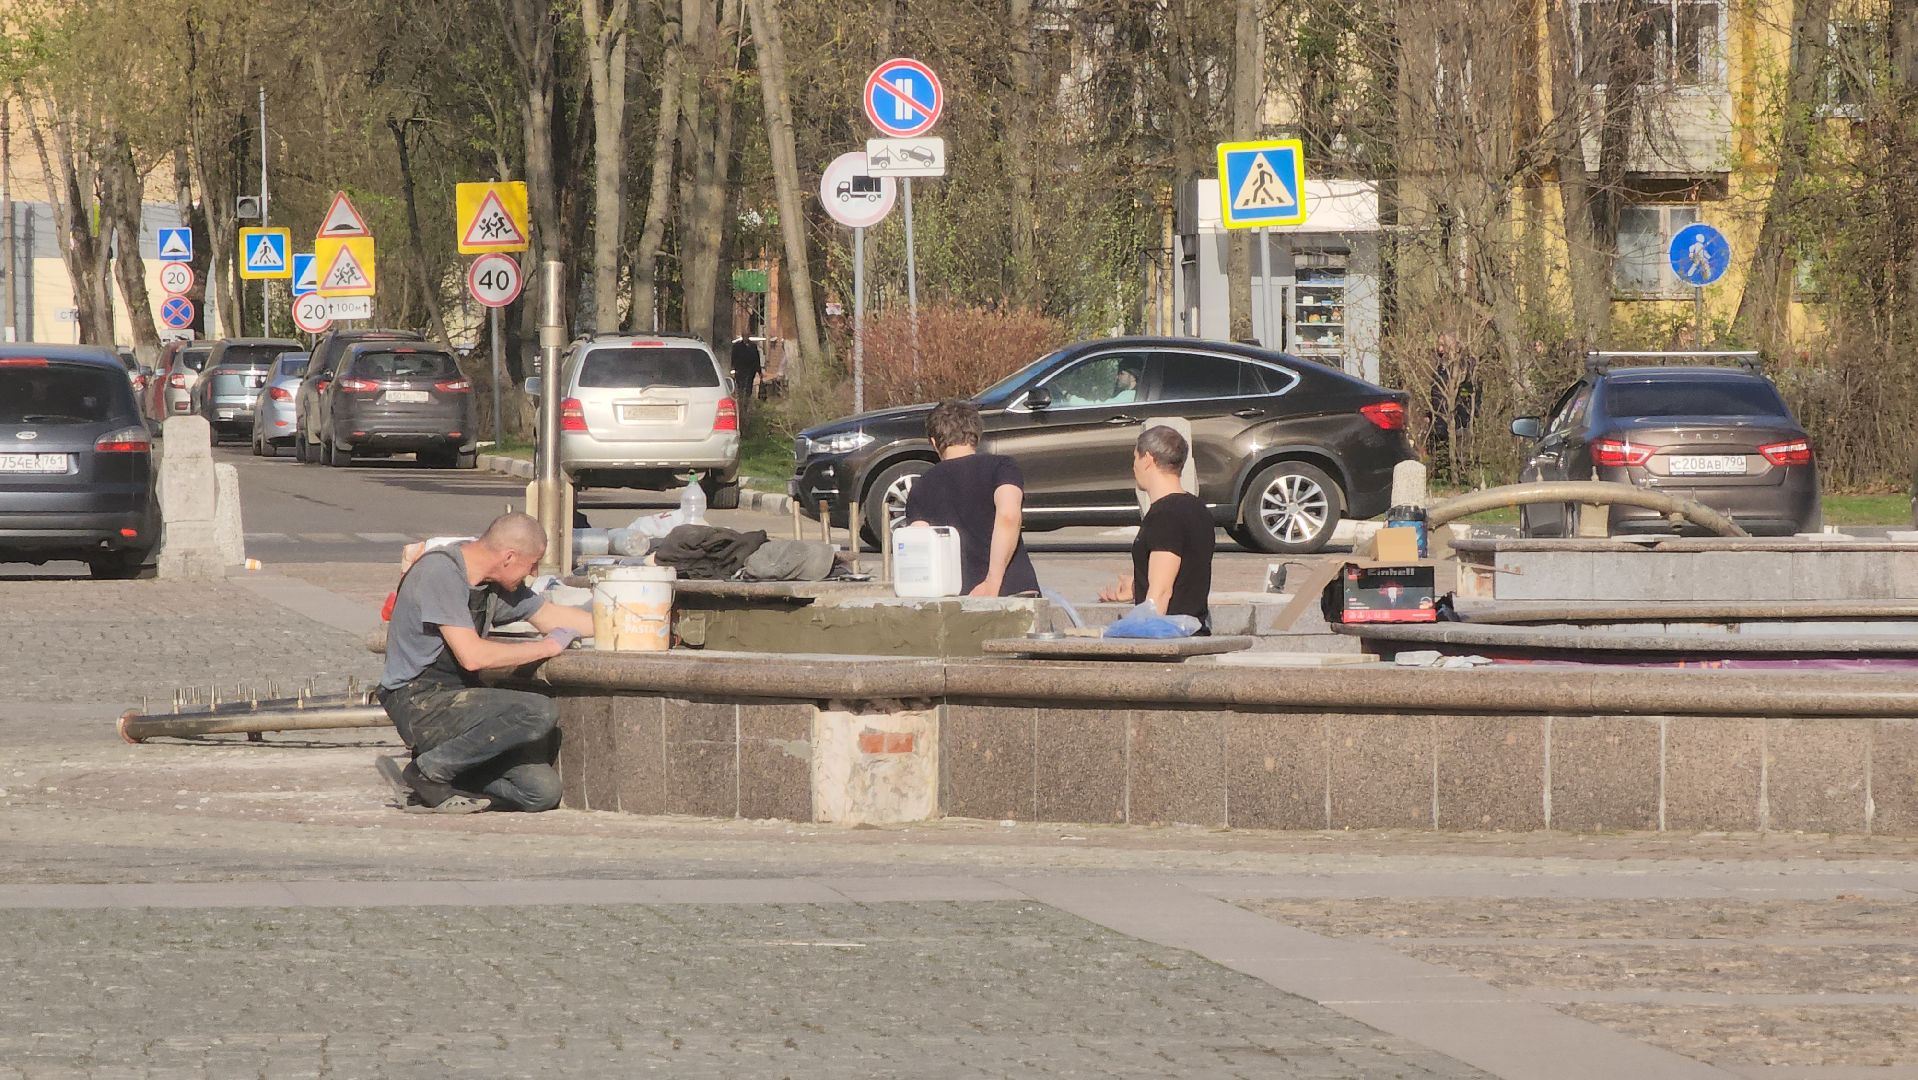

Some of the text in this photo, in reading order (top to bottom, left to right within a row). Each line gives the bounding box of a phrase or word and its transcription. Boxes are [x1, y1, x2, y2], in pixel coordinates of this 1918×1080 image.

[167, 272, 185, 285] 20
[479, 270, 509, 290] 40
[303, 304, 325, 320] 20
